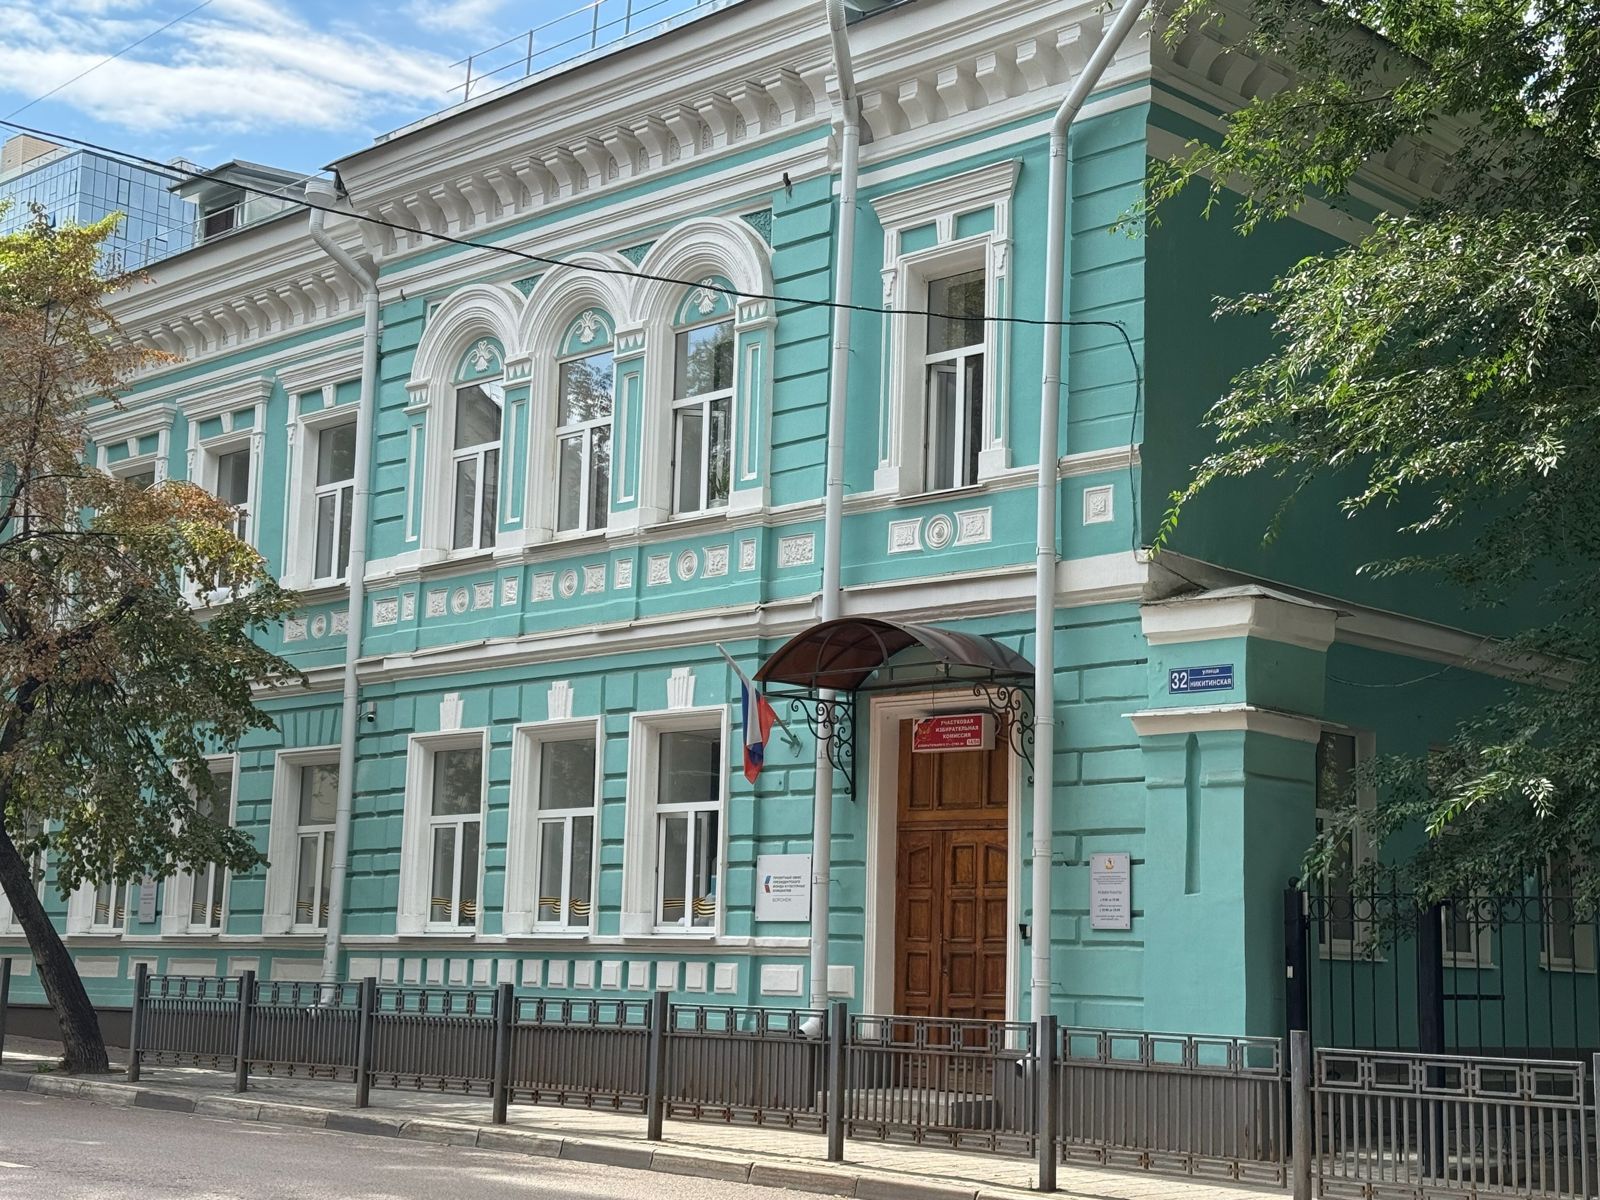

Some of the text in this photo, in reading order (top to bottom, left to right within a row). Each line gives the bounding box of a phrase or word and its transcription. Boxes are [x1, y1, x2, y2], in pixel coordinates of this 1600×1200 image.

[1171, 672, 1187, 689] 32
[1190, 678, 1231, 687] НИКИТИНСКАЯ
[940, 718, 974, 726] УЧАСТКОВАЯ
[935, 725, 979, 733] ИЗБИРАТЕЛЬНАЯ
